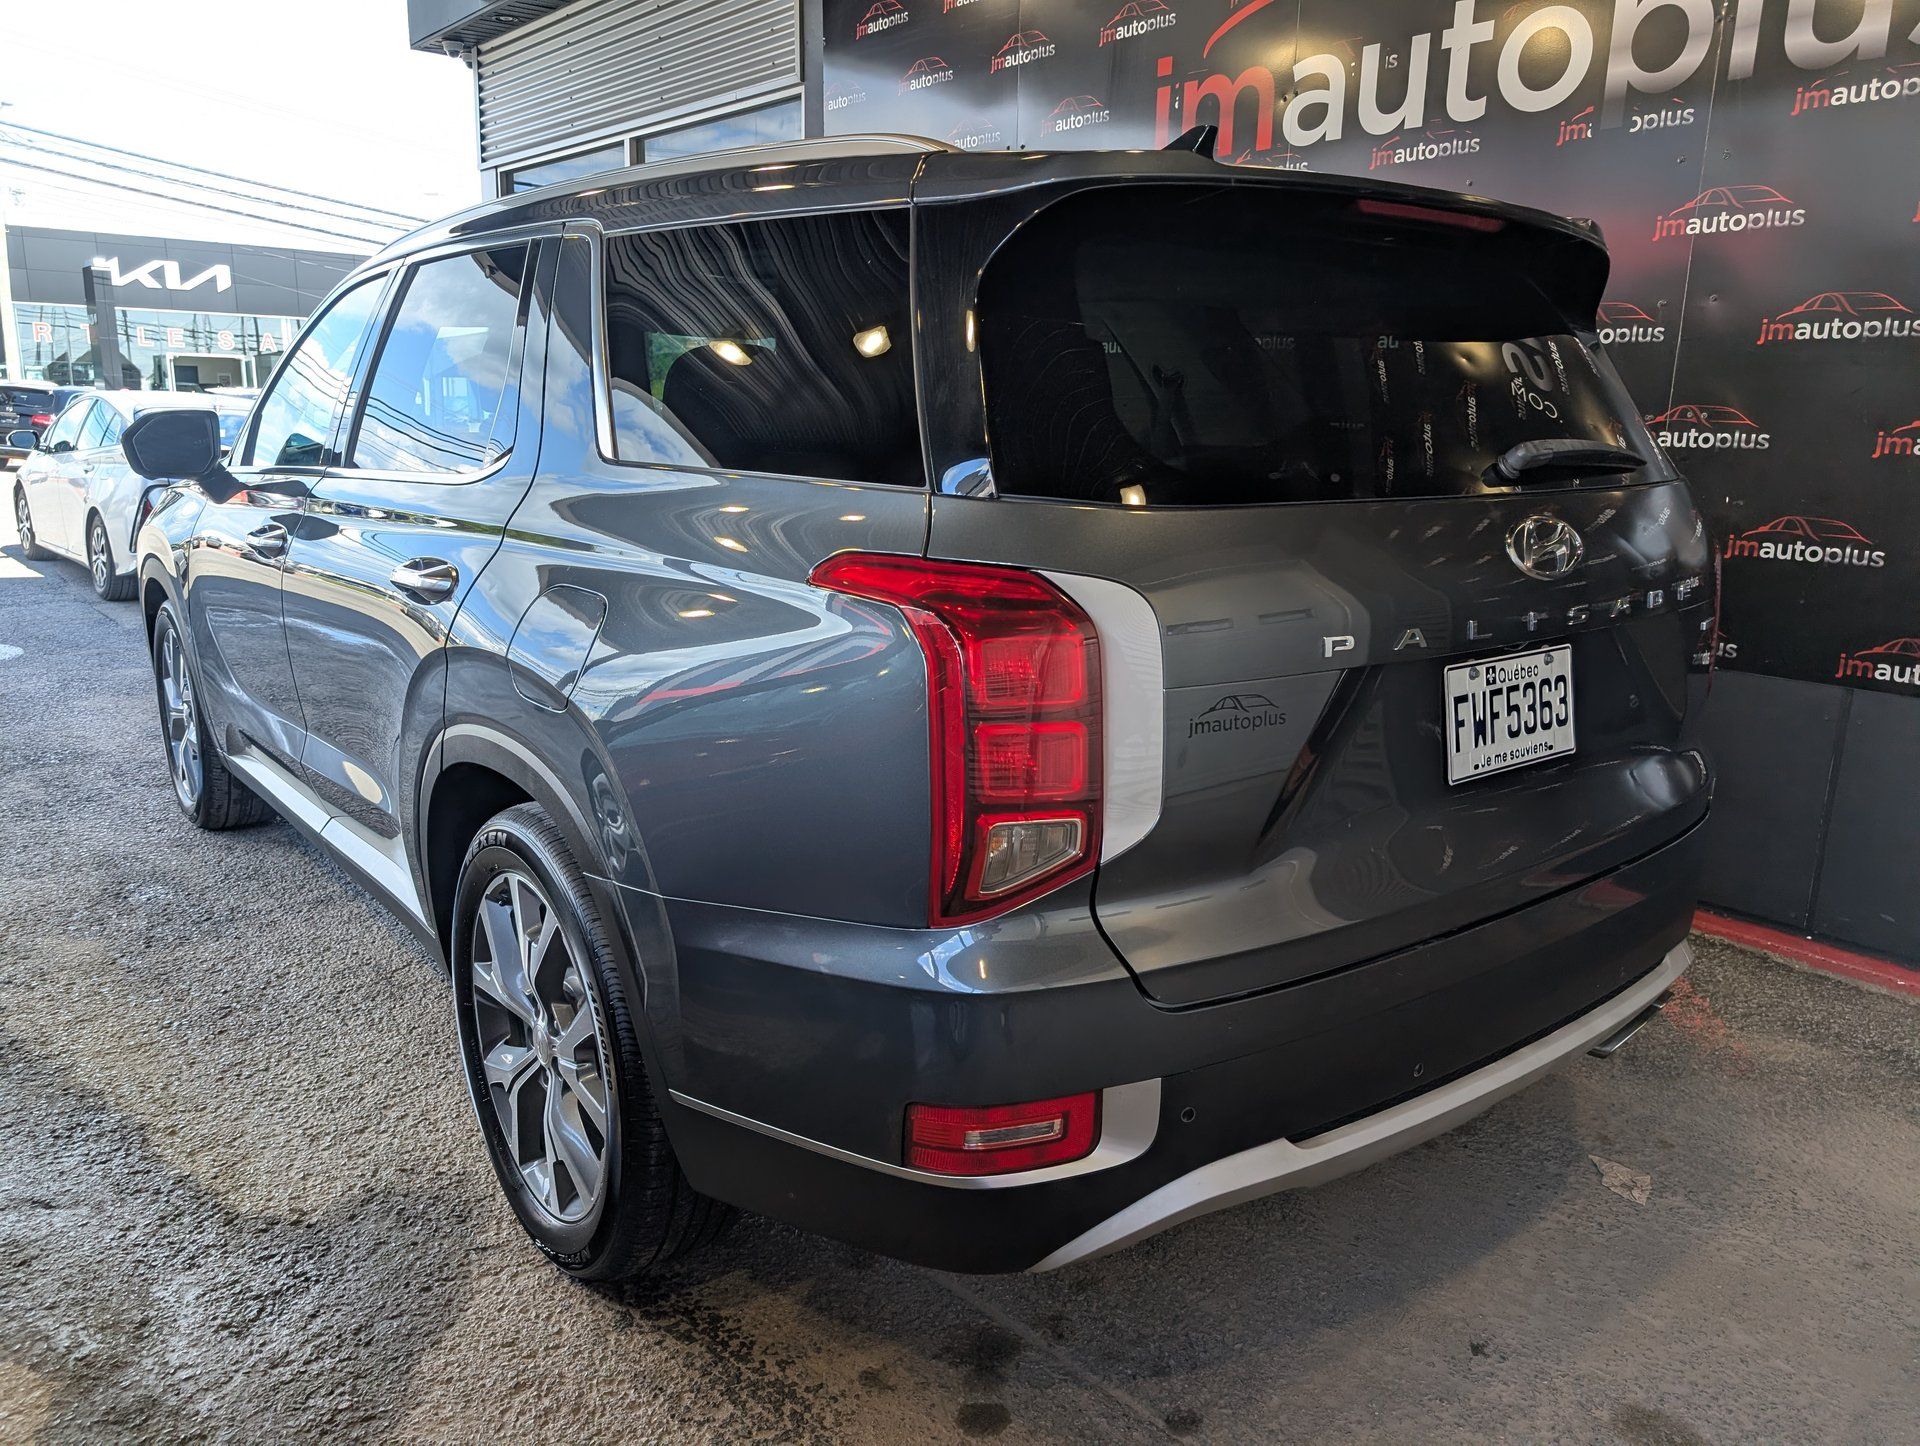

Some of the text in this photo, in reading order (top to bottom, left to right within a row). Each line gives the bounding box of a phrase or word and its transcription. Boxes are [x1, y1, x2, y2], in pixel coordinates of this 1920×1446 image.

[855, 10, 909, 41] jmautoplus
[1099, 11, 1176, 47] jmautoplus
[990, 43, 1055, 74] jmautoplus
[1154, 0, 1920, 158] jmautoplu
[1790, 76, 1920, 117] jmautop
[1369, 138, 1480, 171] jmautoplus
[1652, 207, 1806, 242] jmautoplus
[1597, 325, 1665, 345] oplus
[1756, 316, 1920, 345] jmautoplus
[1655, 427, 1771, 451] autoplus
[1724, 534, 1886, 568] jmautoplus
[1498, 664, 1539, 684] Québec
[1188, 709, 1287, 739] jmautoplus
[1453, 674, 1569, 754] FWF5363
[1480, 740, 1549, 769] Je me souviens
[465, 831, 508, 866] NEXEN
